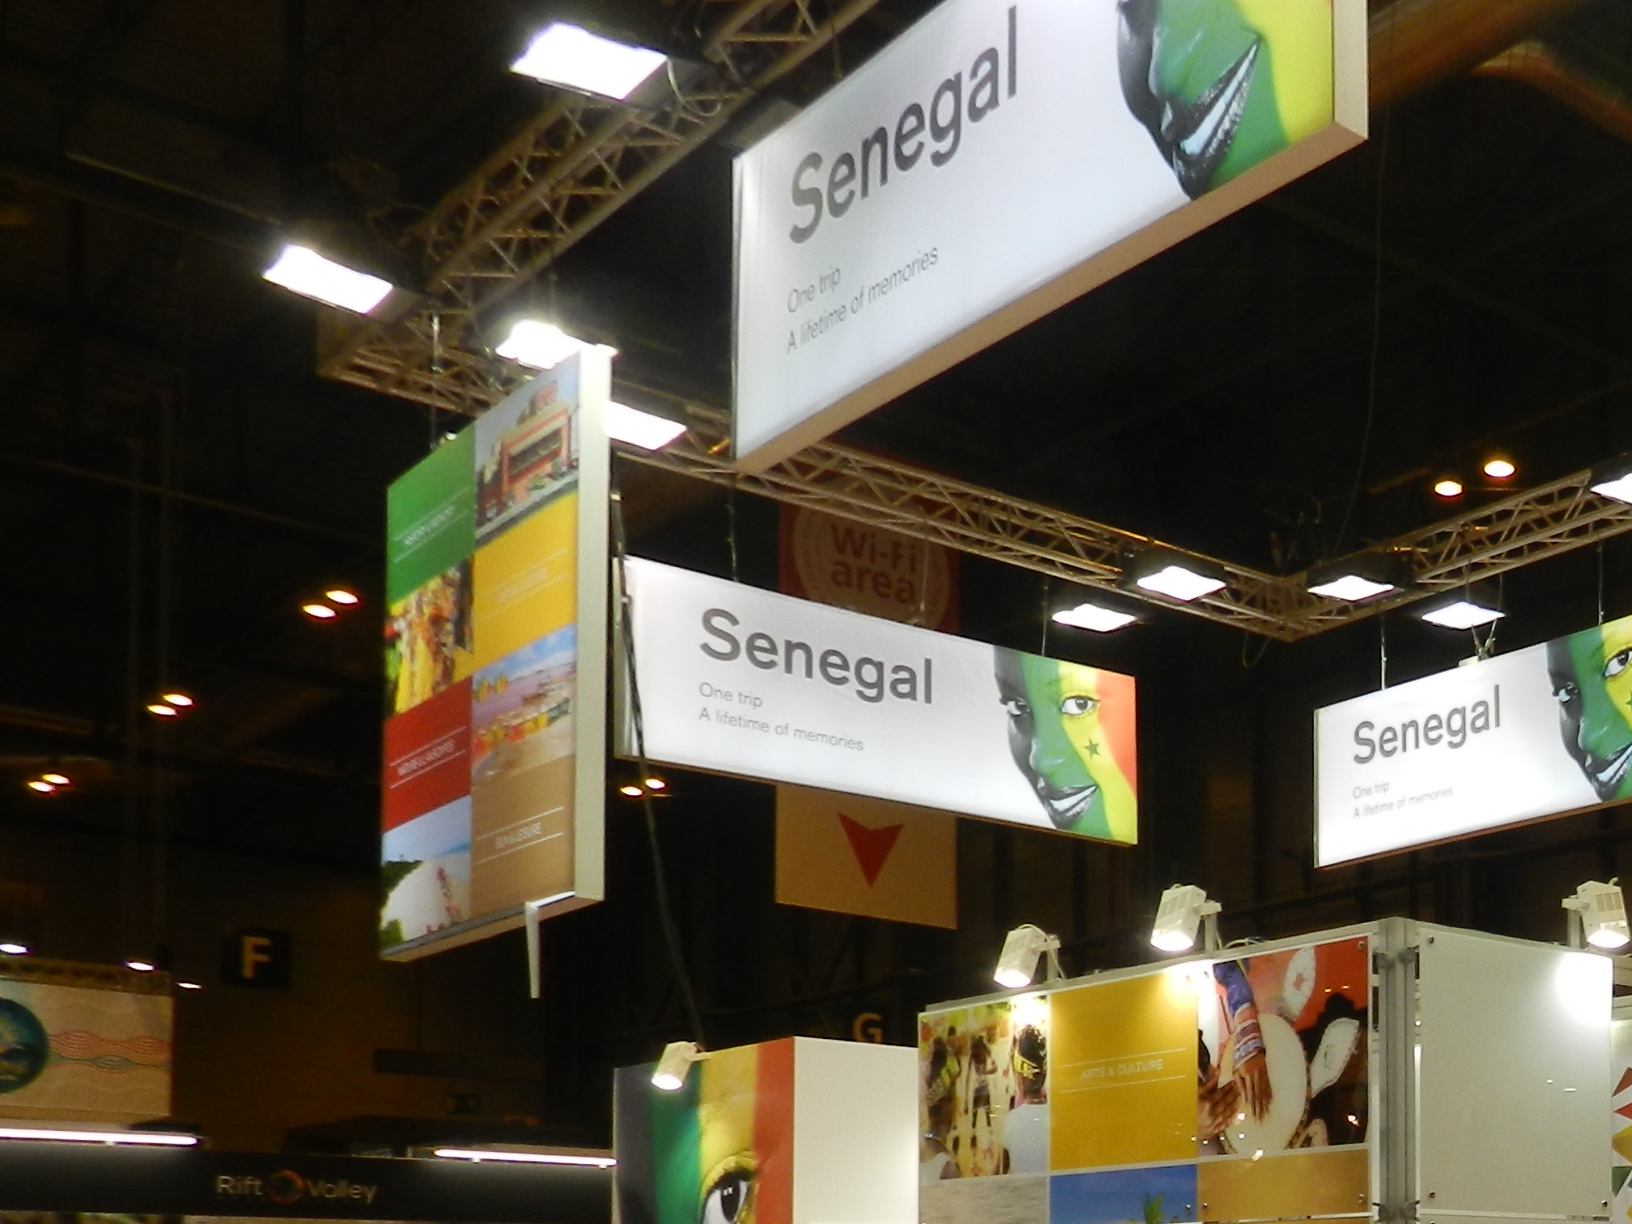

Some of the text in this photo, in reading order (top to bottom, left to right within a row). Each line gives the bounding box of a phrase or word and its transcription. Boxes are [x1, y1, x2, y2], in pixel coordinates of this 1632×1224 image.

[790, 5, 1017, 244] Senegal
[787, 266, 840, 313] One trip
[787, 247, 938, 355] A lifetime of memories
[830, 523, 916, 574] Wi-Fi
[831, 560, 914, 604] area
[700, 608, 932, 704] Senegal
[699, 682, 763, 710] One trip
[699, 707, 864, 751] A lifetime of memories
[1353, 684, 1500, 764] Senegal
[1353, 781, 1389, 799] One trip
[1353, 787, 1454, 819] A lifetime of memories
[243, 936, 270, 979] F
[853, 1012, 883, 1043] G
[1081, 1067, 1105, 1080] ARTS
[1116, 1059, 1163, 1075] CULTURE
[216, 1175, 377, 1204] Rift Valley
